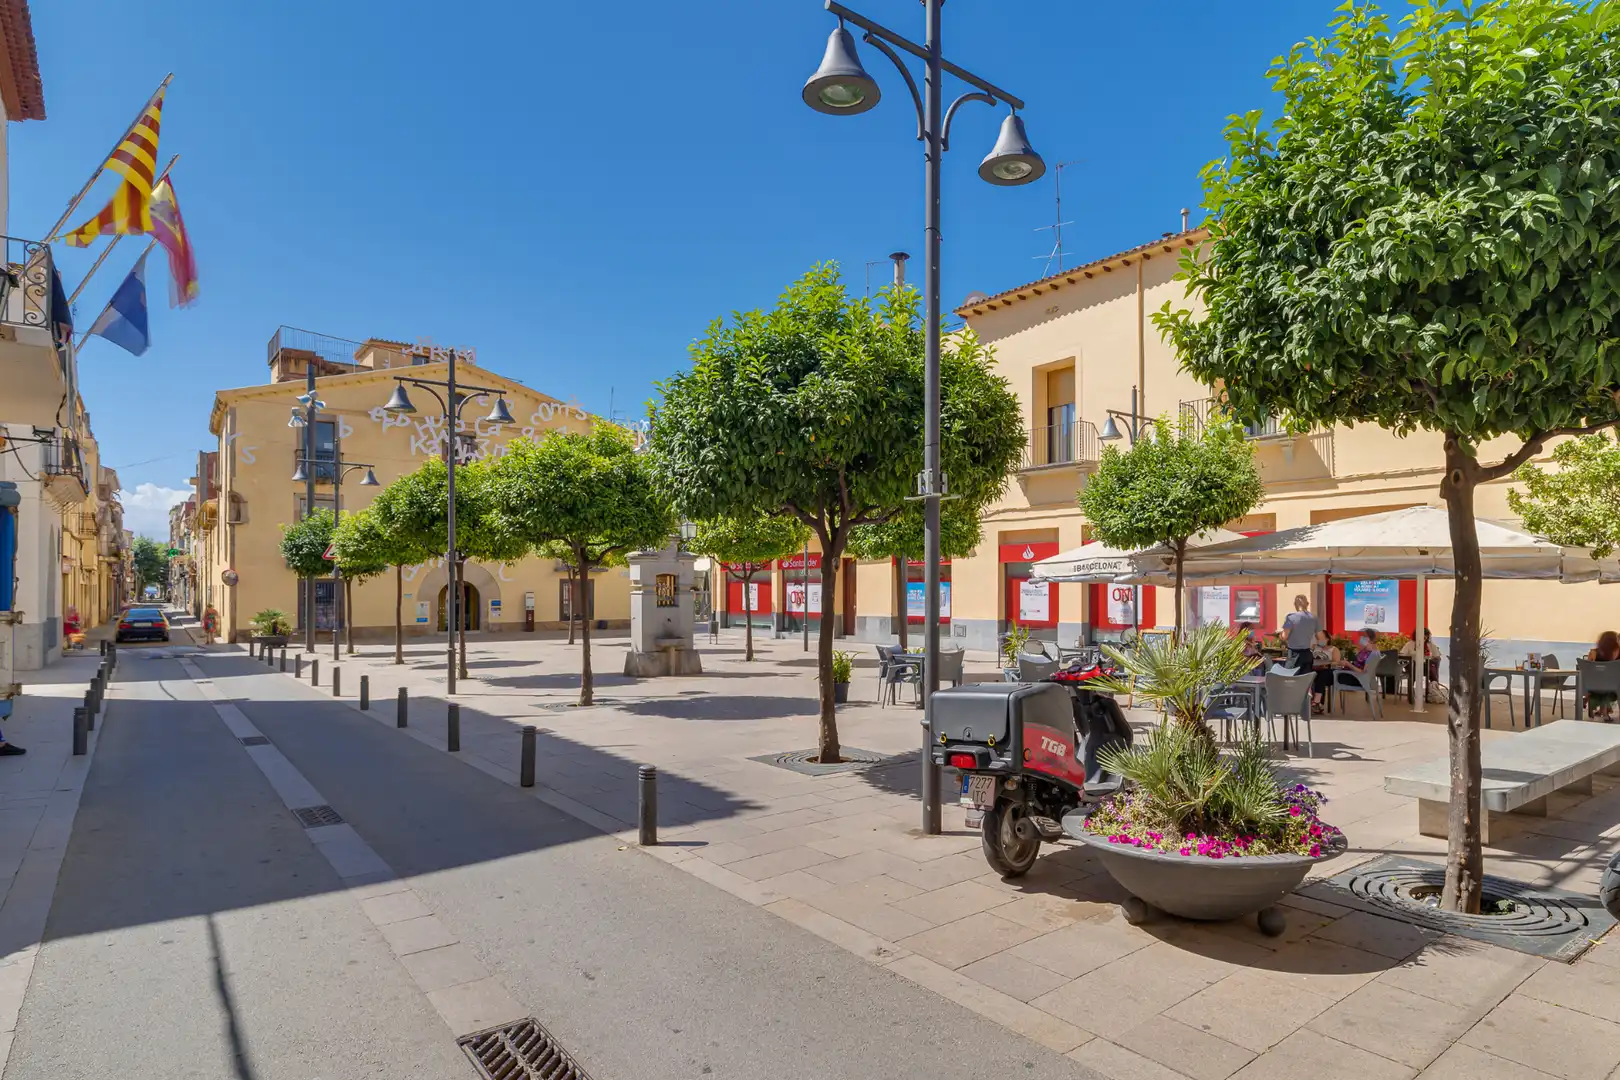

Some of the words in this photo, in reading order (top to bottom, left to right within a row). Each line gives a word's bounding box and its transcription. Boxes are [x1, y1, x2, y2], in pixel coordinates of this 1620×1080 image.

[789, 558, 818, 567] Santader
[1041, 736, 1067, 757] TGB
[970, 776, 993, 789] 7277
[972, 790, 987, 803] ITC
